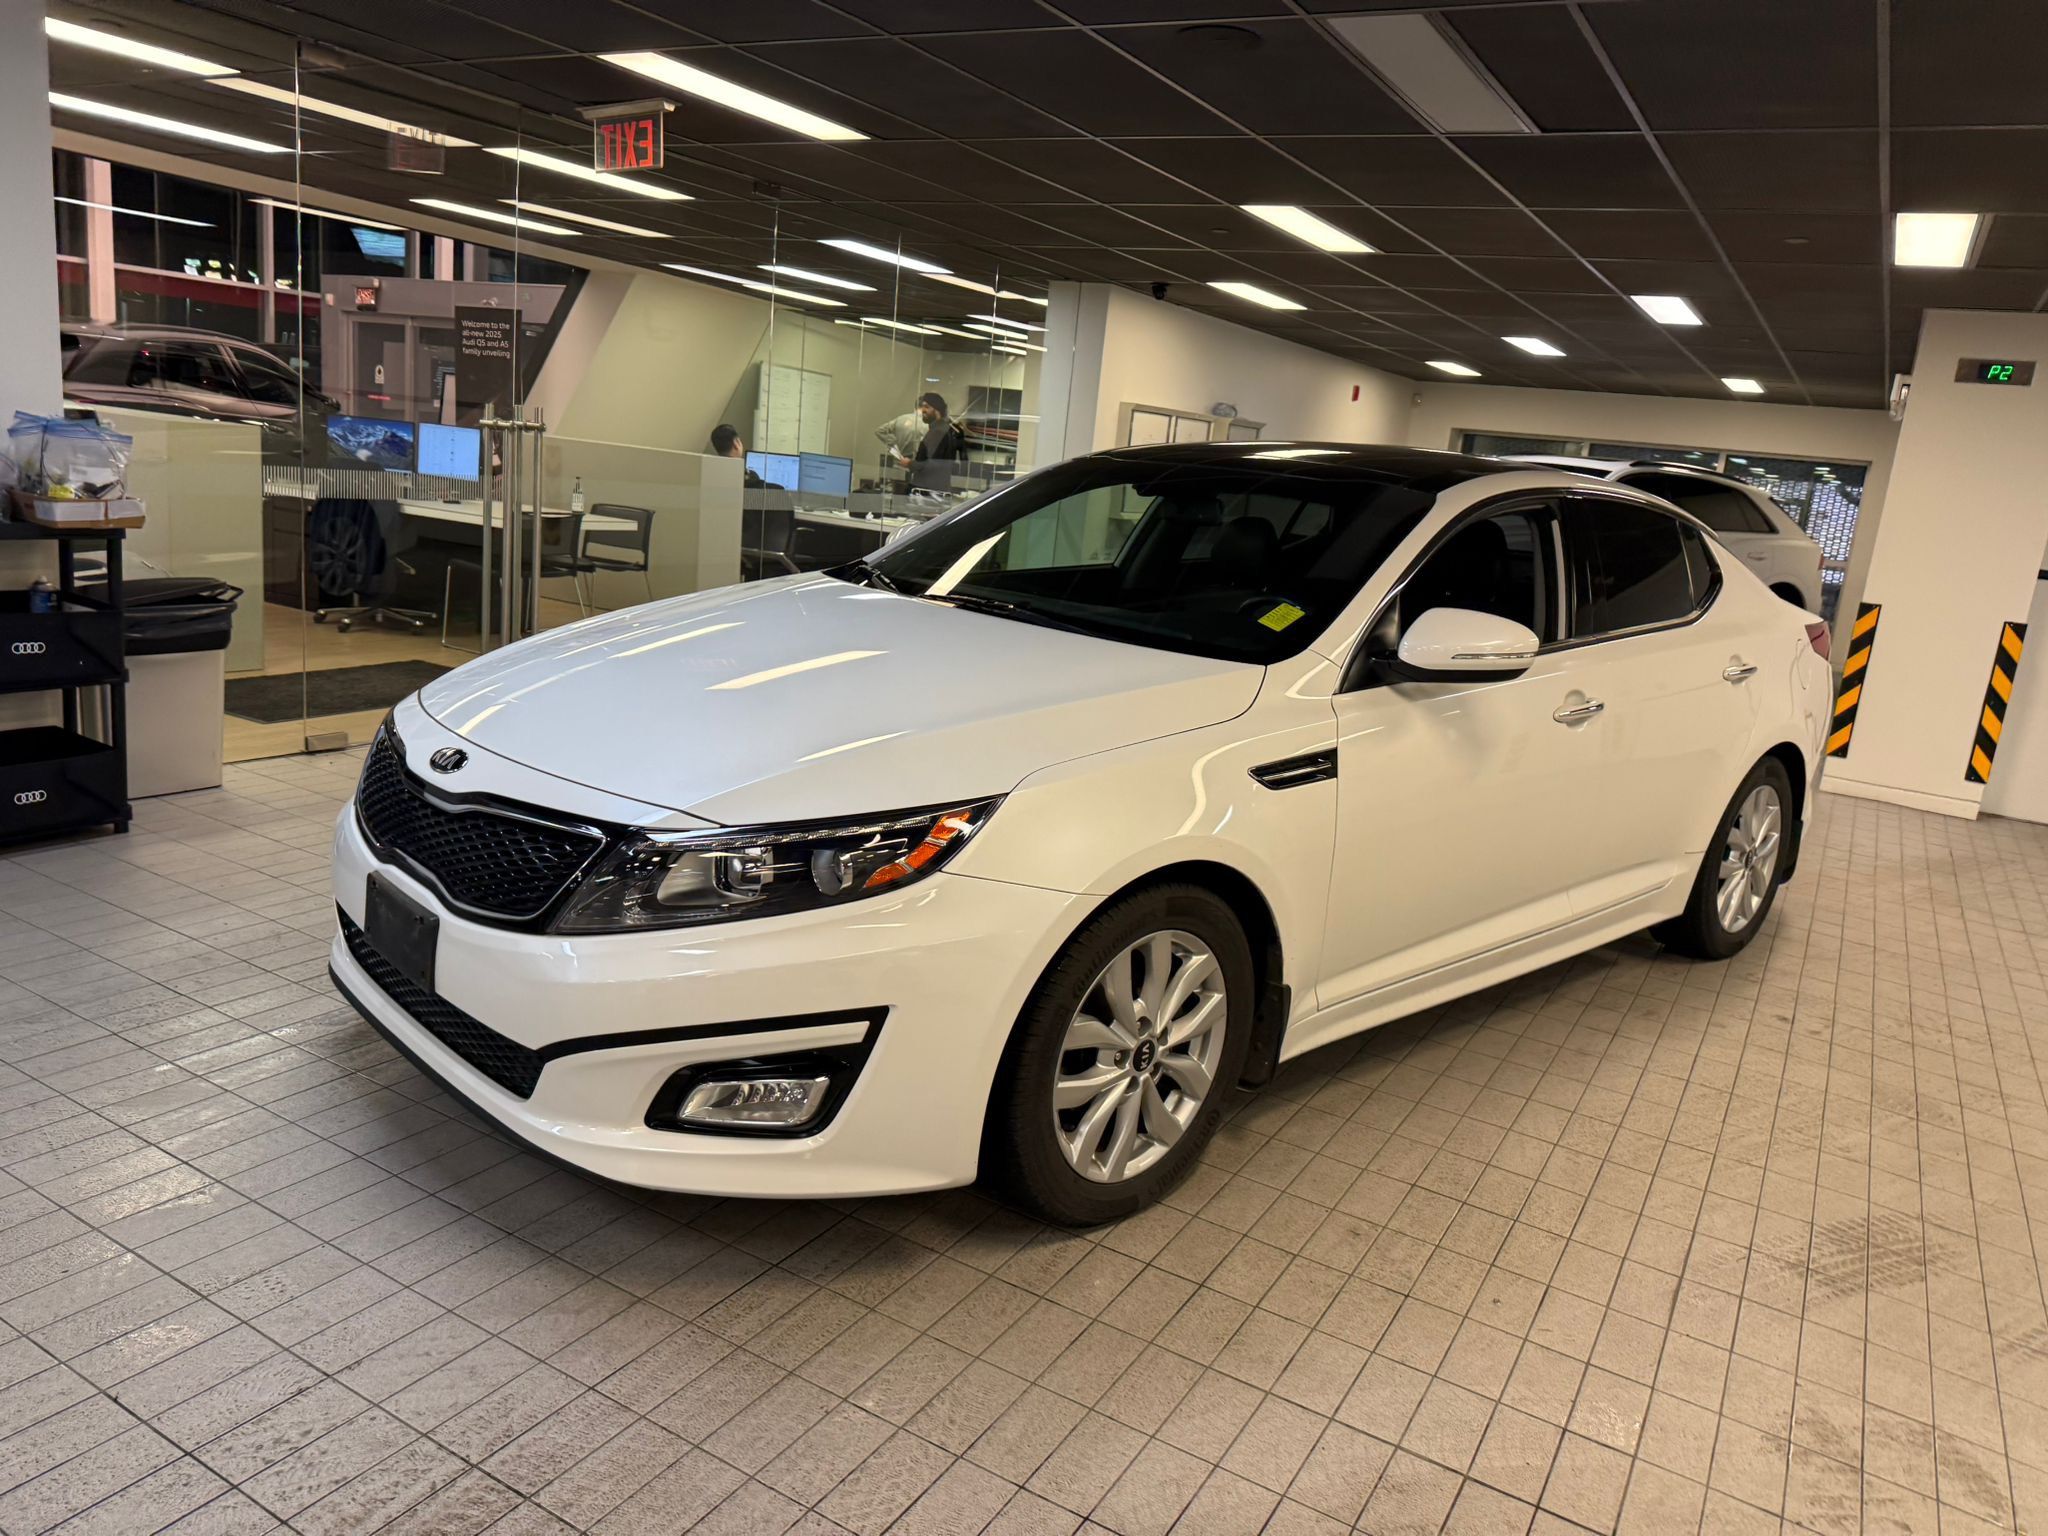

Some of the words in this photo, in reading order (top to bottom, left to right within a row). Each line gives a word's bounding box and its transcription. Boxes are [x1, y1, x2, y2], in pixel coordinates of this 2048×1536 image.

[461, 320, 490, 329] Welcome
[485, 330, 502, 339] 2025
[462, 338, 476, 346] Audi
[476, 339, 486, 347] Q5
[487, 340, 499, 348] and
[500, 340, 509, 348] A5
[462, 347, 481, 357] family
[482, 350, 510, 359] unveiling
[1987, 365, 2013, 380] P2
[431, 748, 461, 770] KIA
[1140, 1043, 1150, 1069] KIA
